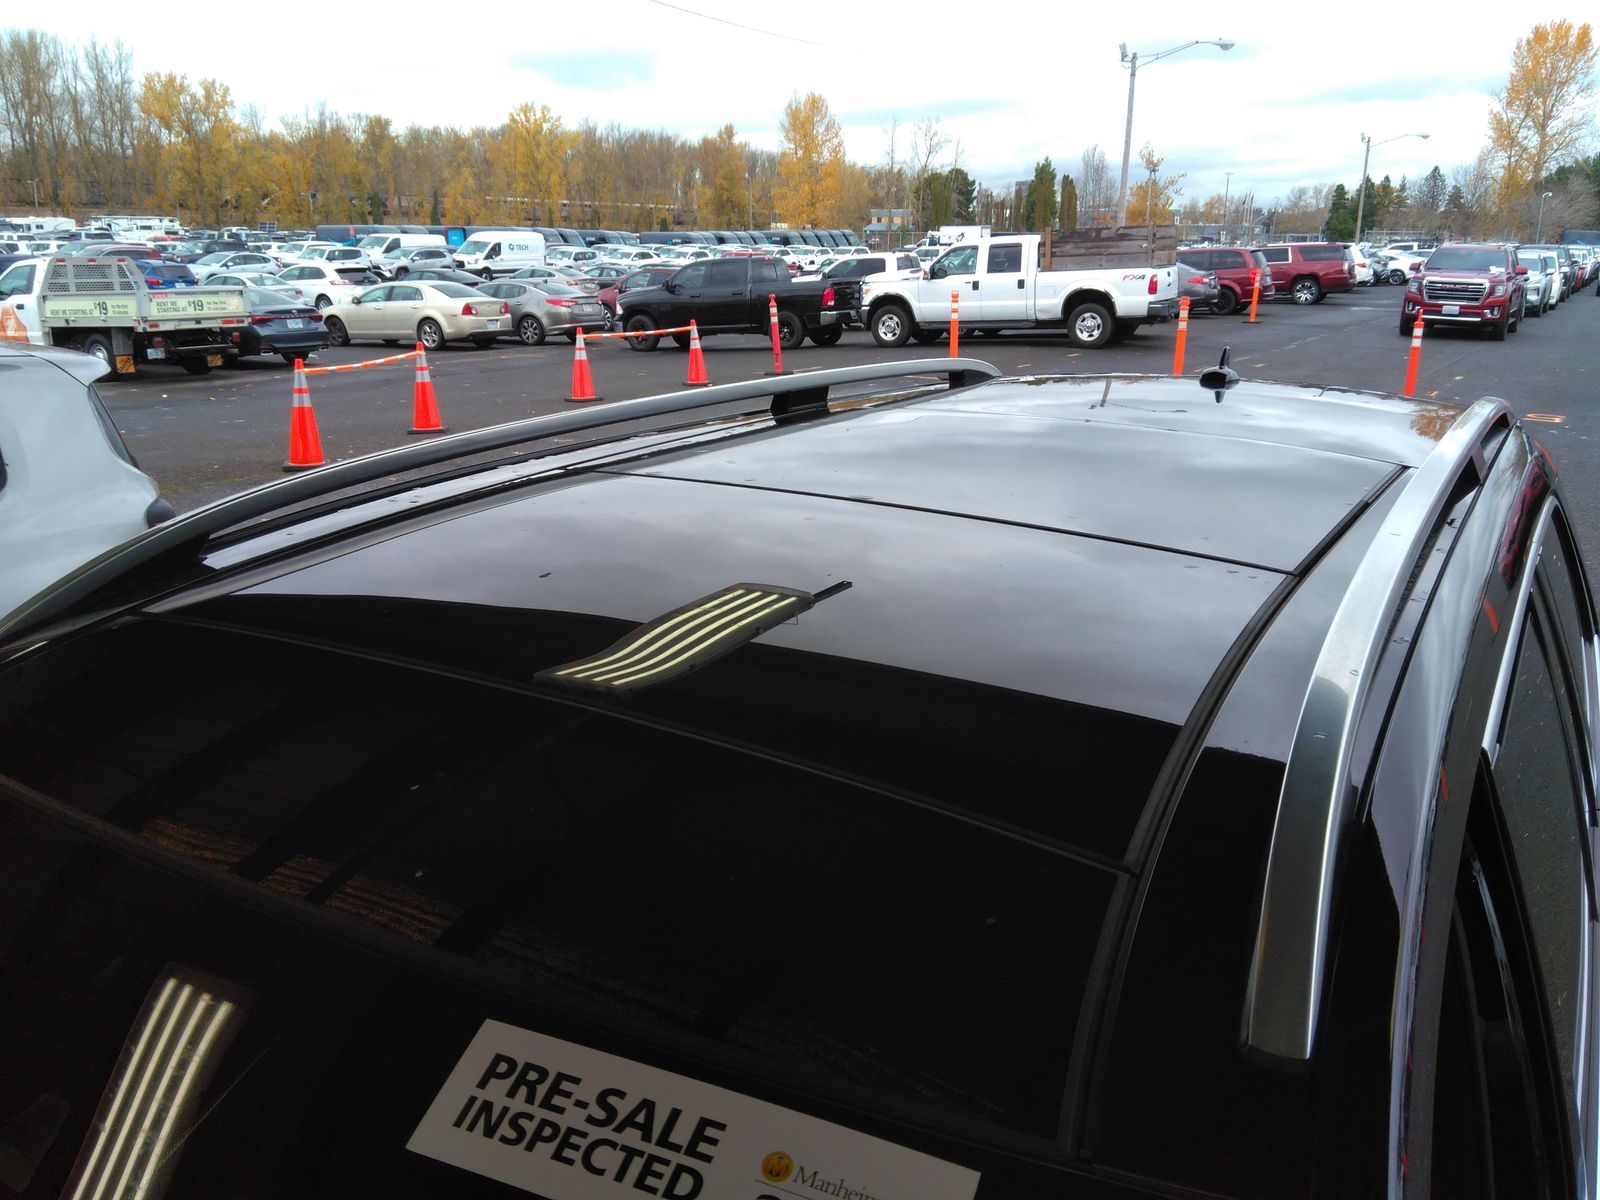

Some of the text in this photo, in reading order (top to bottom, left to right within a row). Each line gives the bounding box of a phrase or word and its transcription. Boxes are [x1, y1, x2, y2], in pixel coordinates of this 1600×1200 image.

[94, 301, 108, 315] $19
[188, 300, 204, 311] $19
[476, 1053, 727, 1164] PRE-SALE
[453, 1095, 704, 1200] INSPECTED
